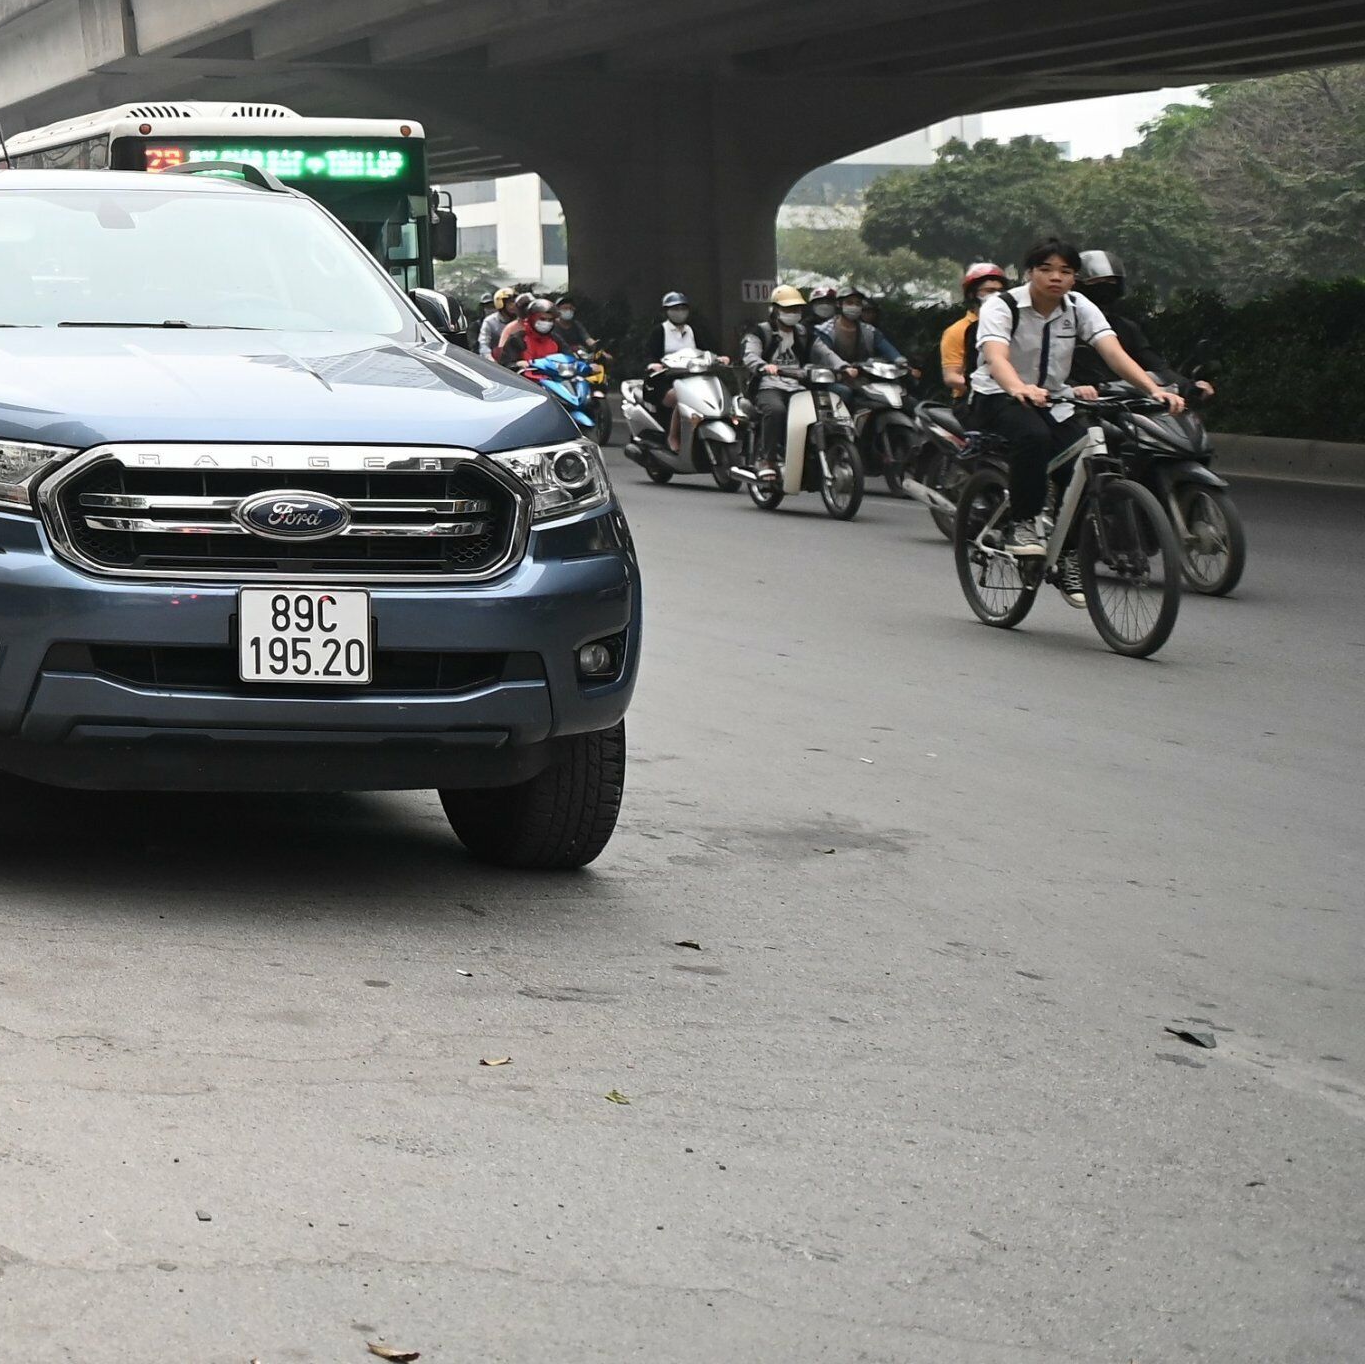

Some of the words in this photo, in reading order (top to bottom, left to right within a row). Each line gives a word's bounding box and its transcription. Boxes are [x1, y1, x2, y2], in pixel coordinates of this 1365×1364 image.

[744, 283, 774, 301] T10
[137, 453, 443, 471] RANGER
[267, 501, 324, 526] Ford
[270, 593, 338, 633] 89C
[249, 635, 366, 677] 195.20
